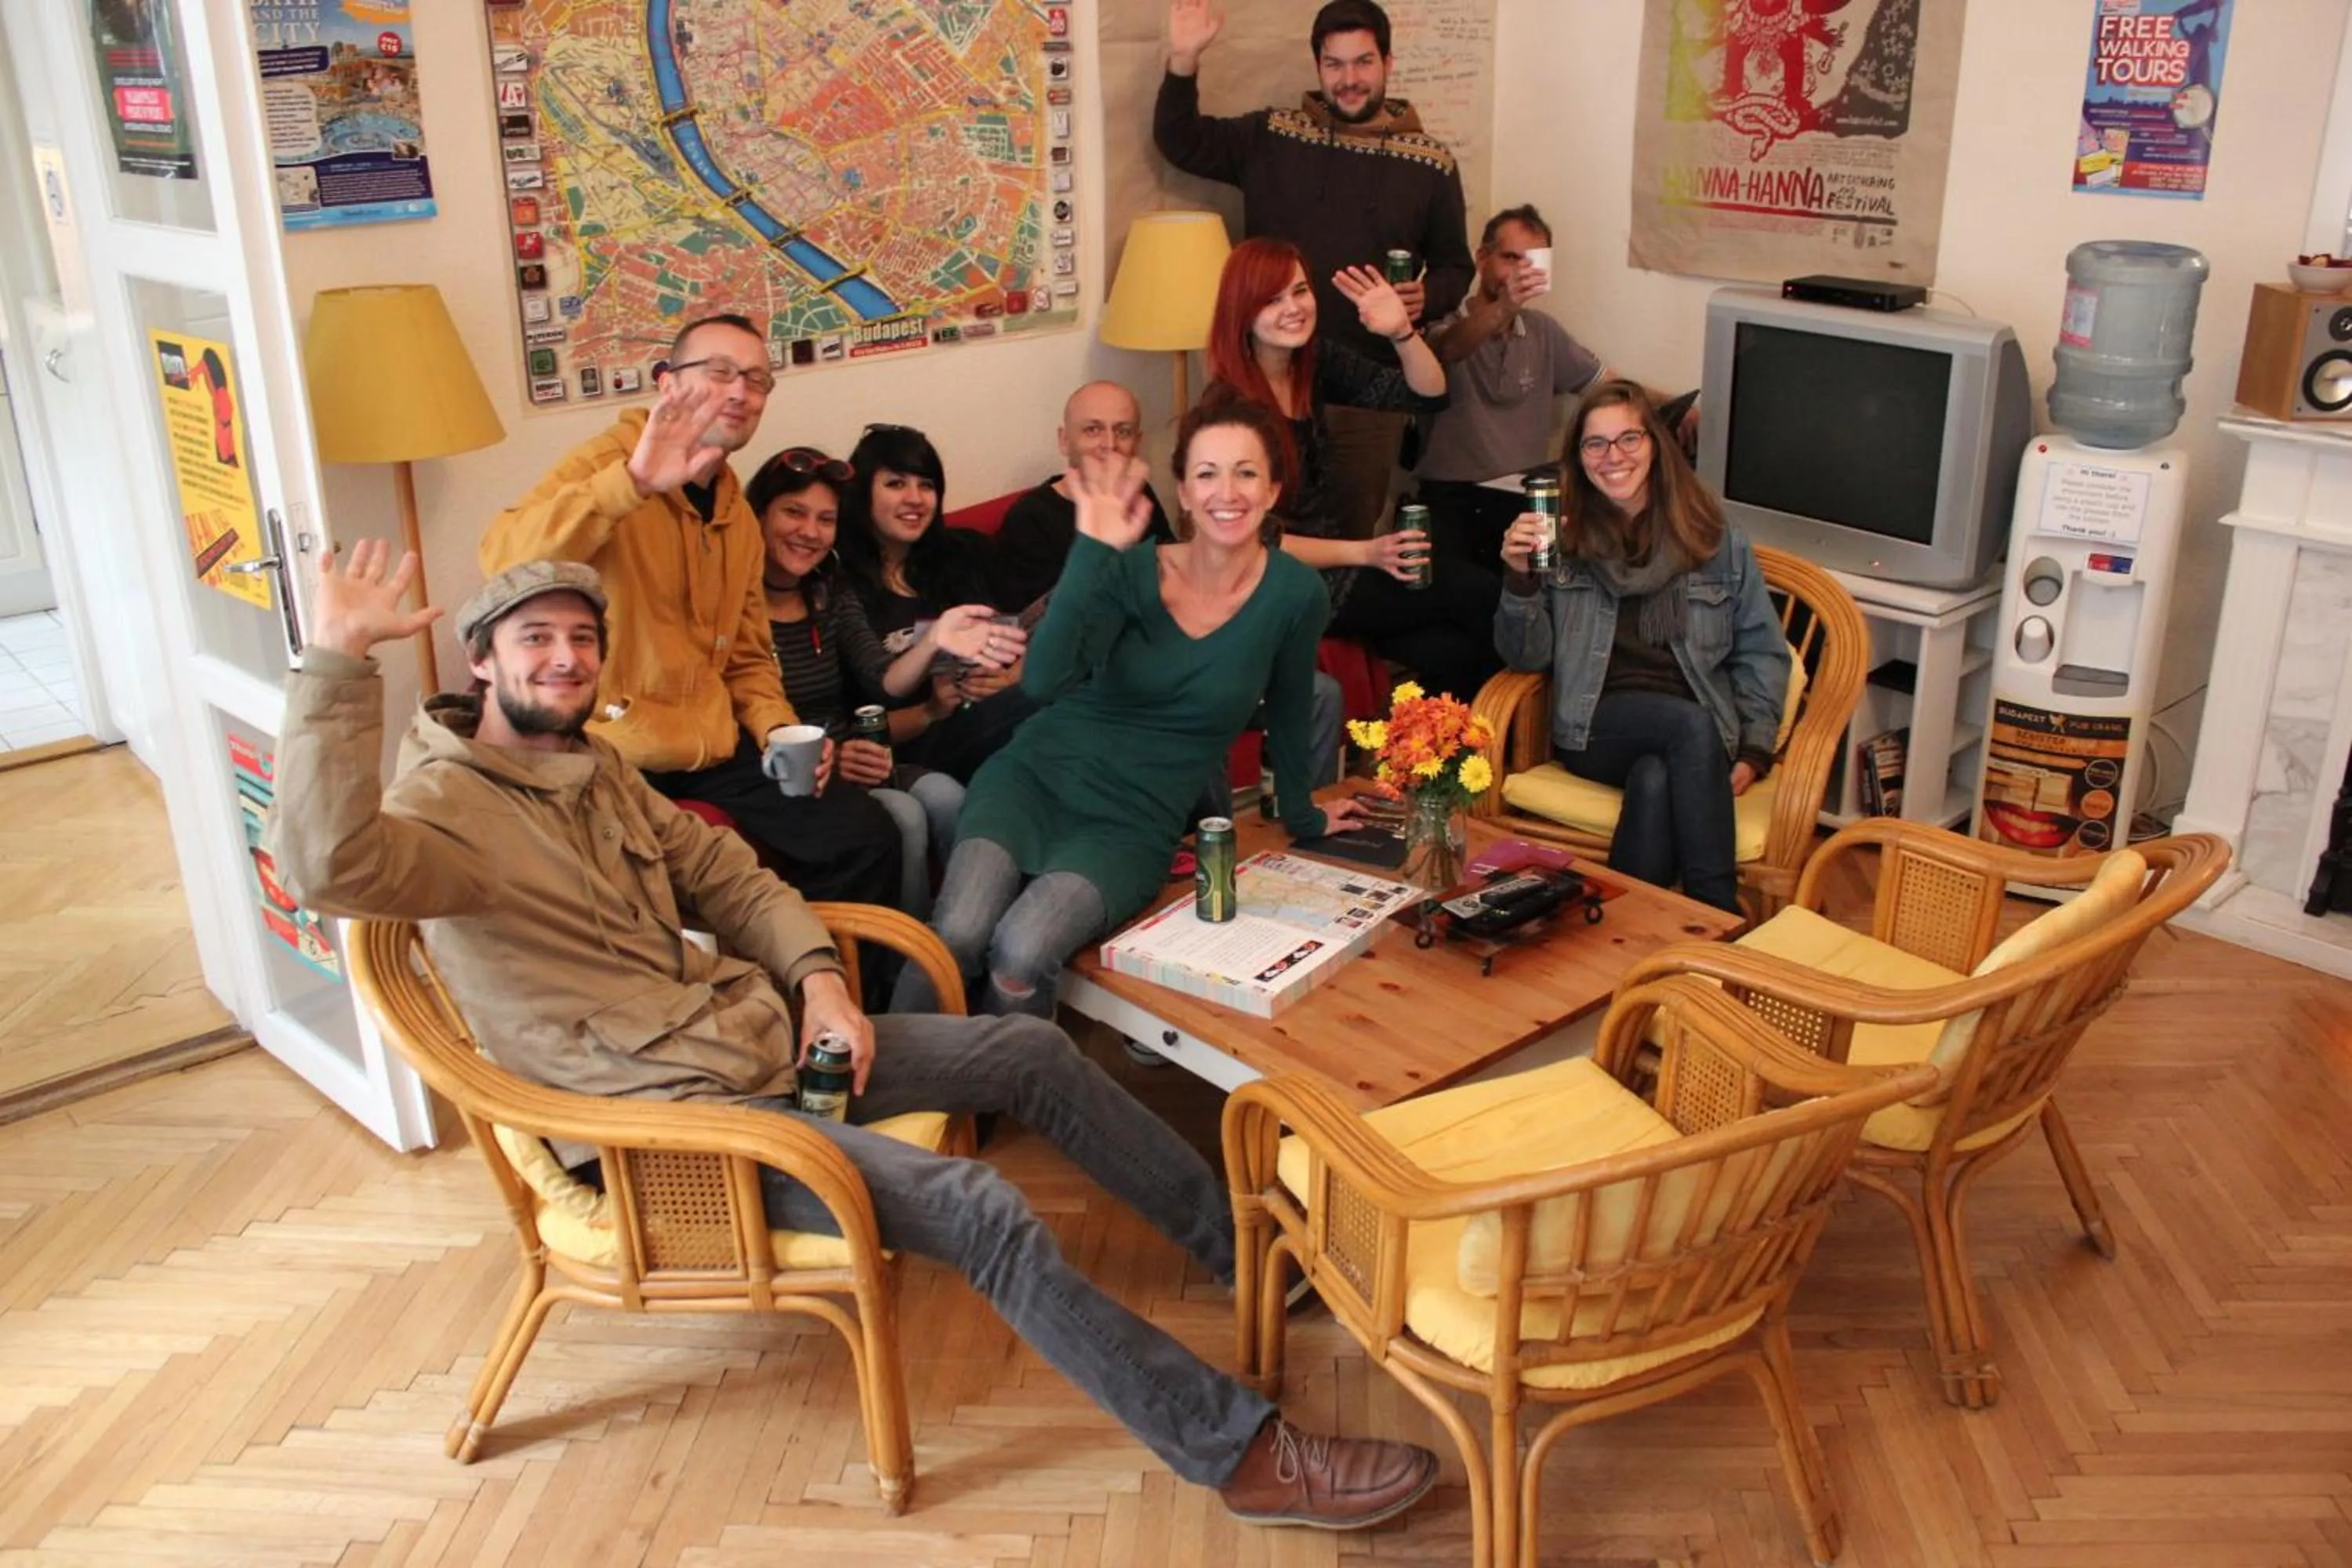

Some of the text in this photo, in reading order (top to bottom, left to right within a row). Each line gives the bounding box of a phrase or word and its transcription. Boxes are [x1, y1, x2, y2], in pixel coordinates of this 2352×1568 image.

[287, 8, 320, 20] THE
[255, 22, 321, 44] CITY
[2101, 16, 2174, 38] FREE
[2100, 40, 2190, 58] WALKING
[2097, 58, 2187, 83] TOURS
[853, 317, 924, 343] Budapest
